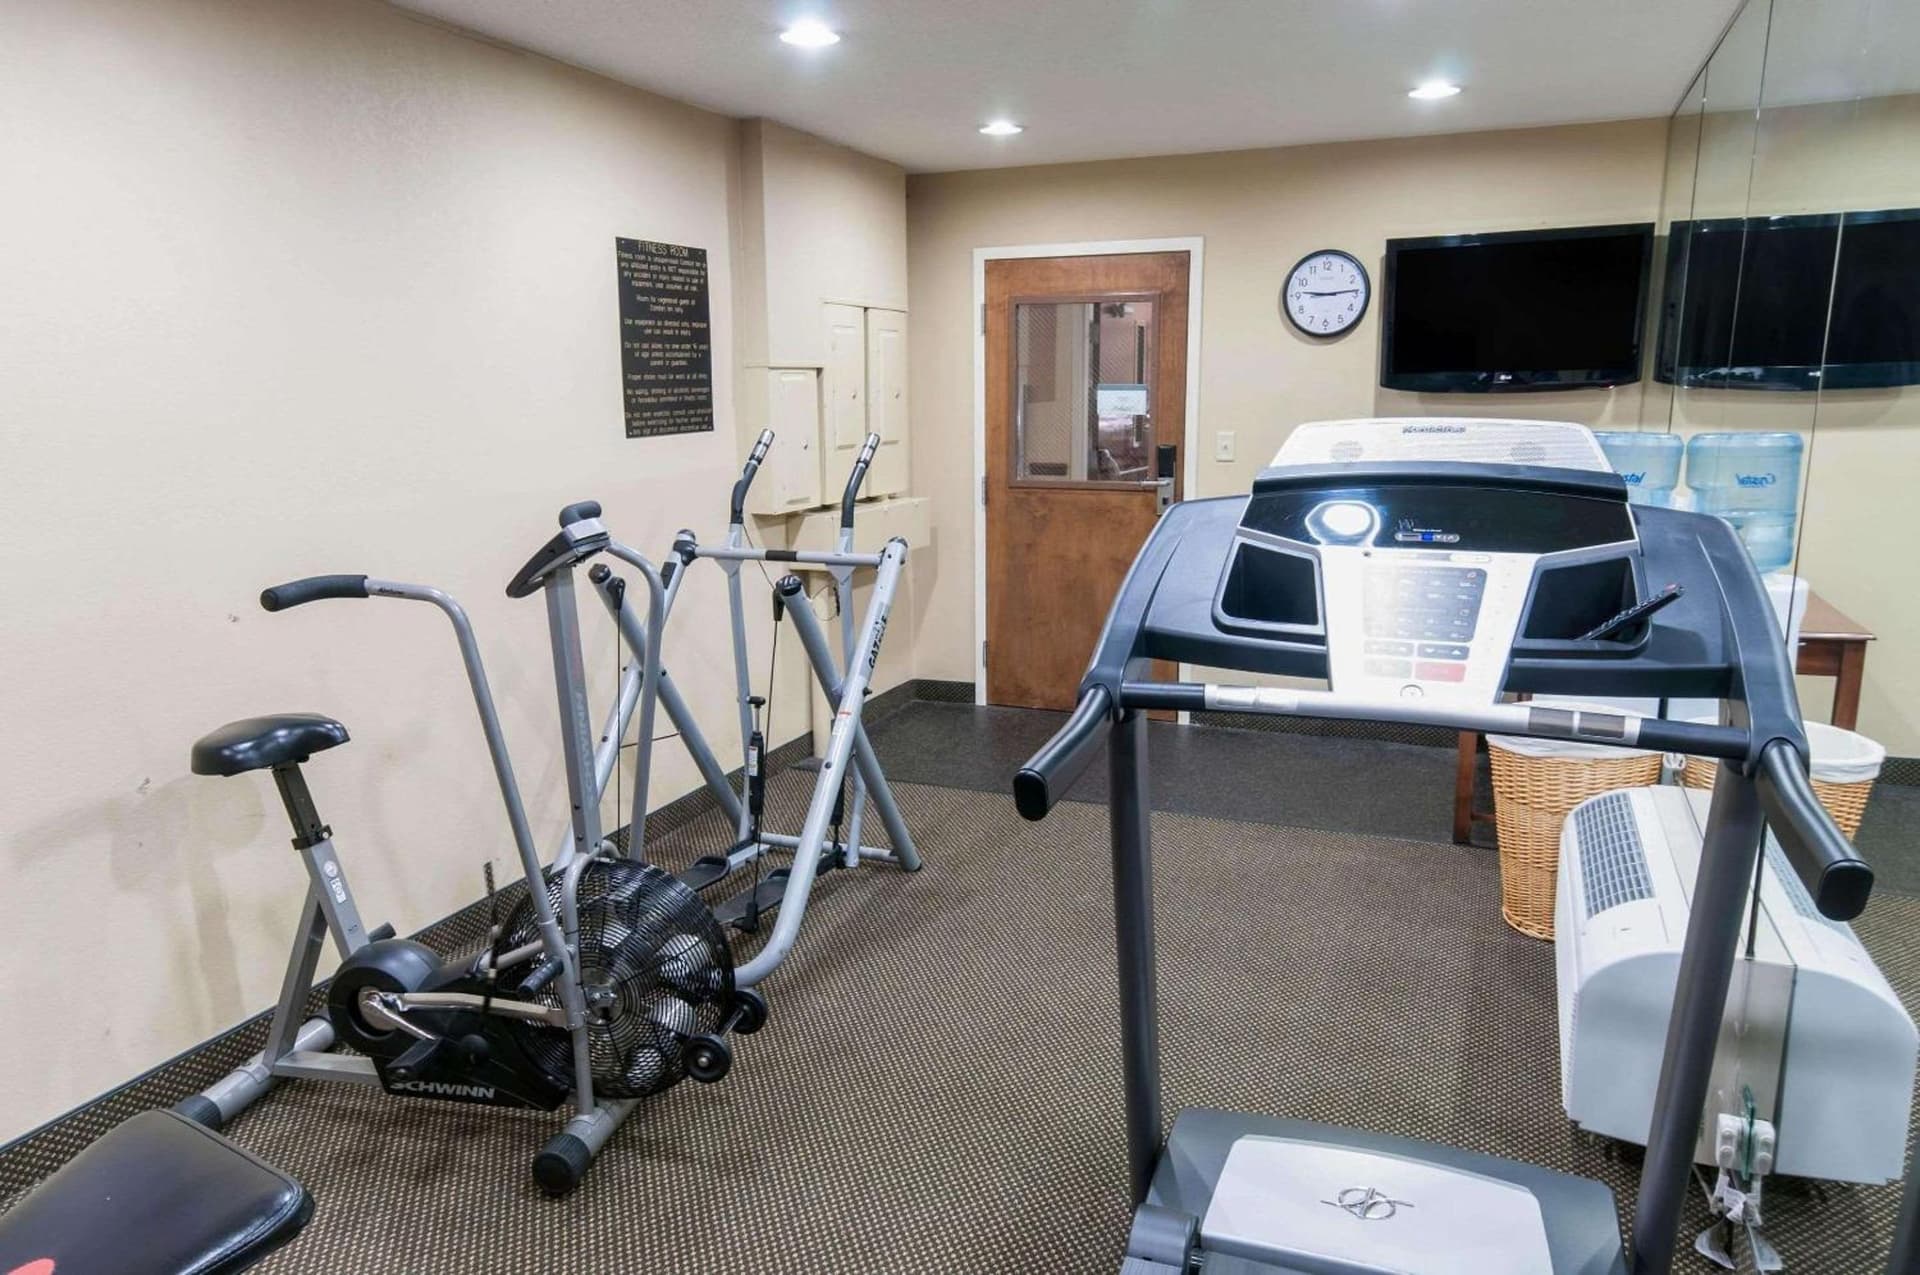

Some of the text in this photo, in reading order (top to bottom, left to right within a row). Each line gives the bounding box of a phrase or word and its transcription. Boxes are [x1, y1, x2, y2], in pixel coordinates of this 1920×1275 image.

[638, 240, 668, 256] FITNESS
[1309, 265, 1317, 274] 11
[1322, 261, 1332, 271] 12
[1340, 264, 1344, 272] 1
[1298, 278, 1308, 287] 10
[1349, 275, 1356, 284] 2
[1294, 291, 1301, 300] 9
[1352, 290, 1359, 298] 3
[1298, 305, 1304, 314] 8
[1347, 303, 1354, 312] 4
[1308, 315, 1315, 324] 7
[1322, 318, 1329, 327] 6
[1337, 314, 1344, 323] 5
[390, 1080, 496, 1099] SCHWINN
